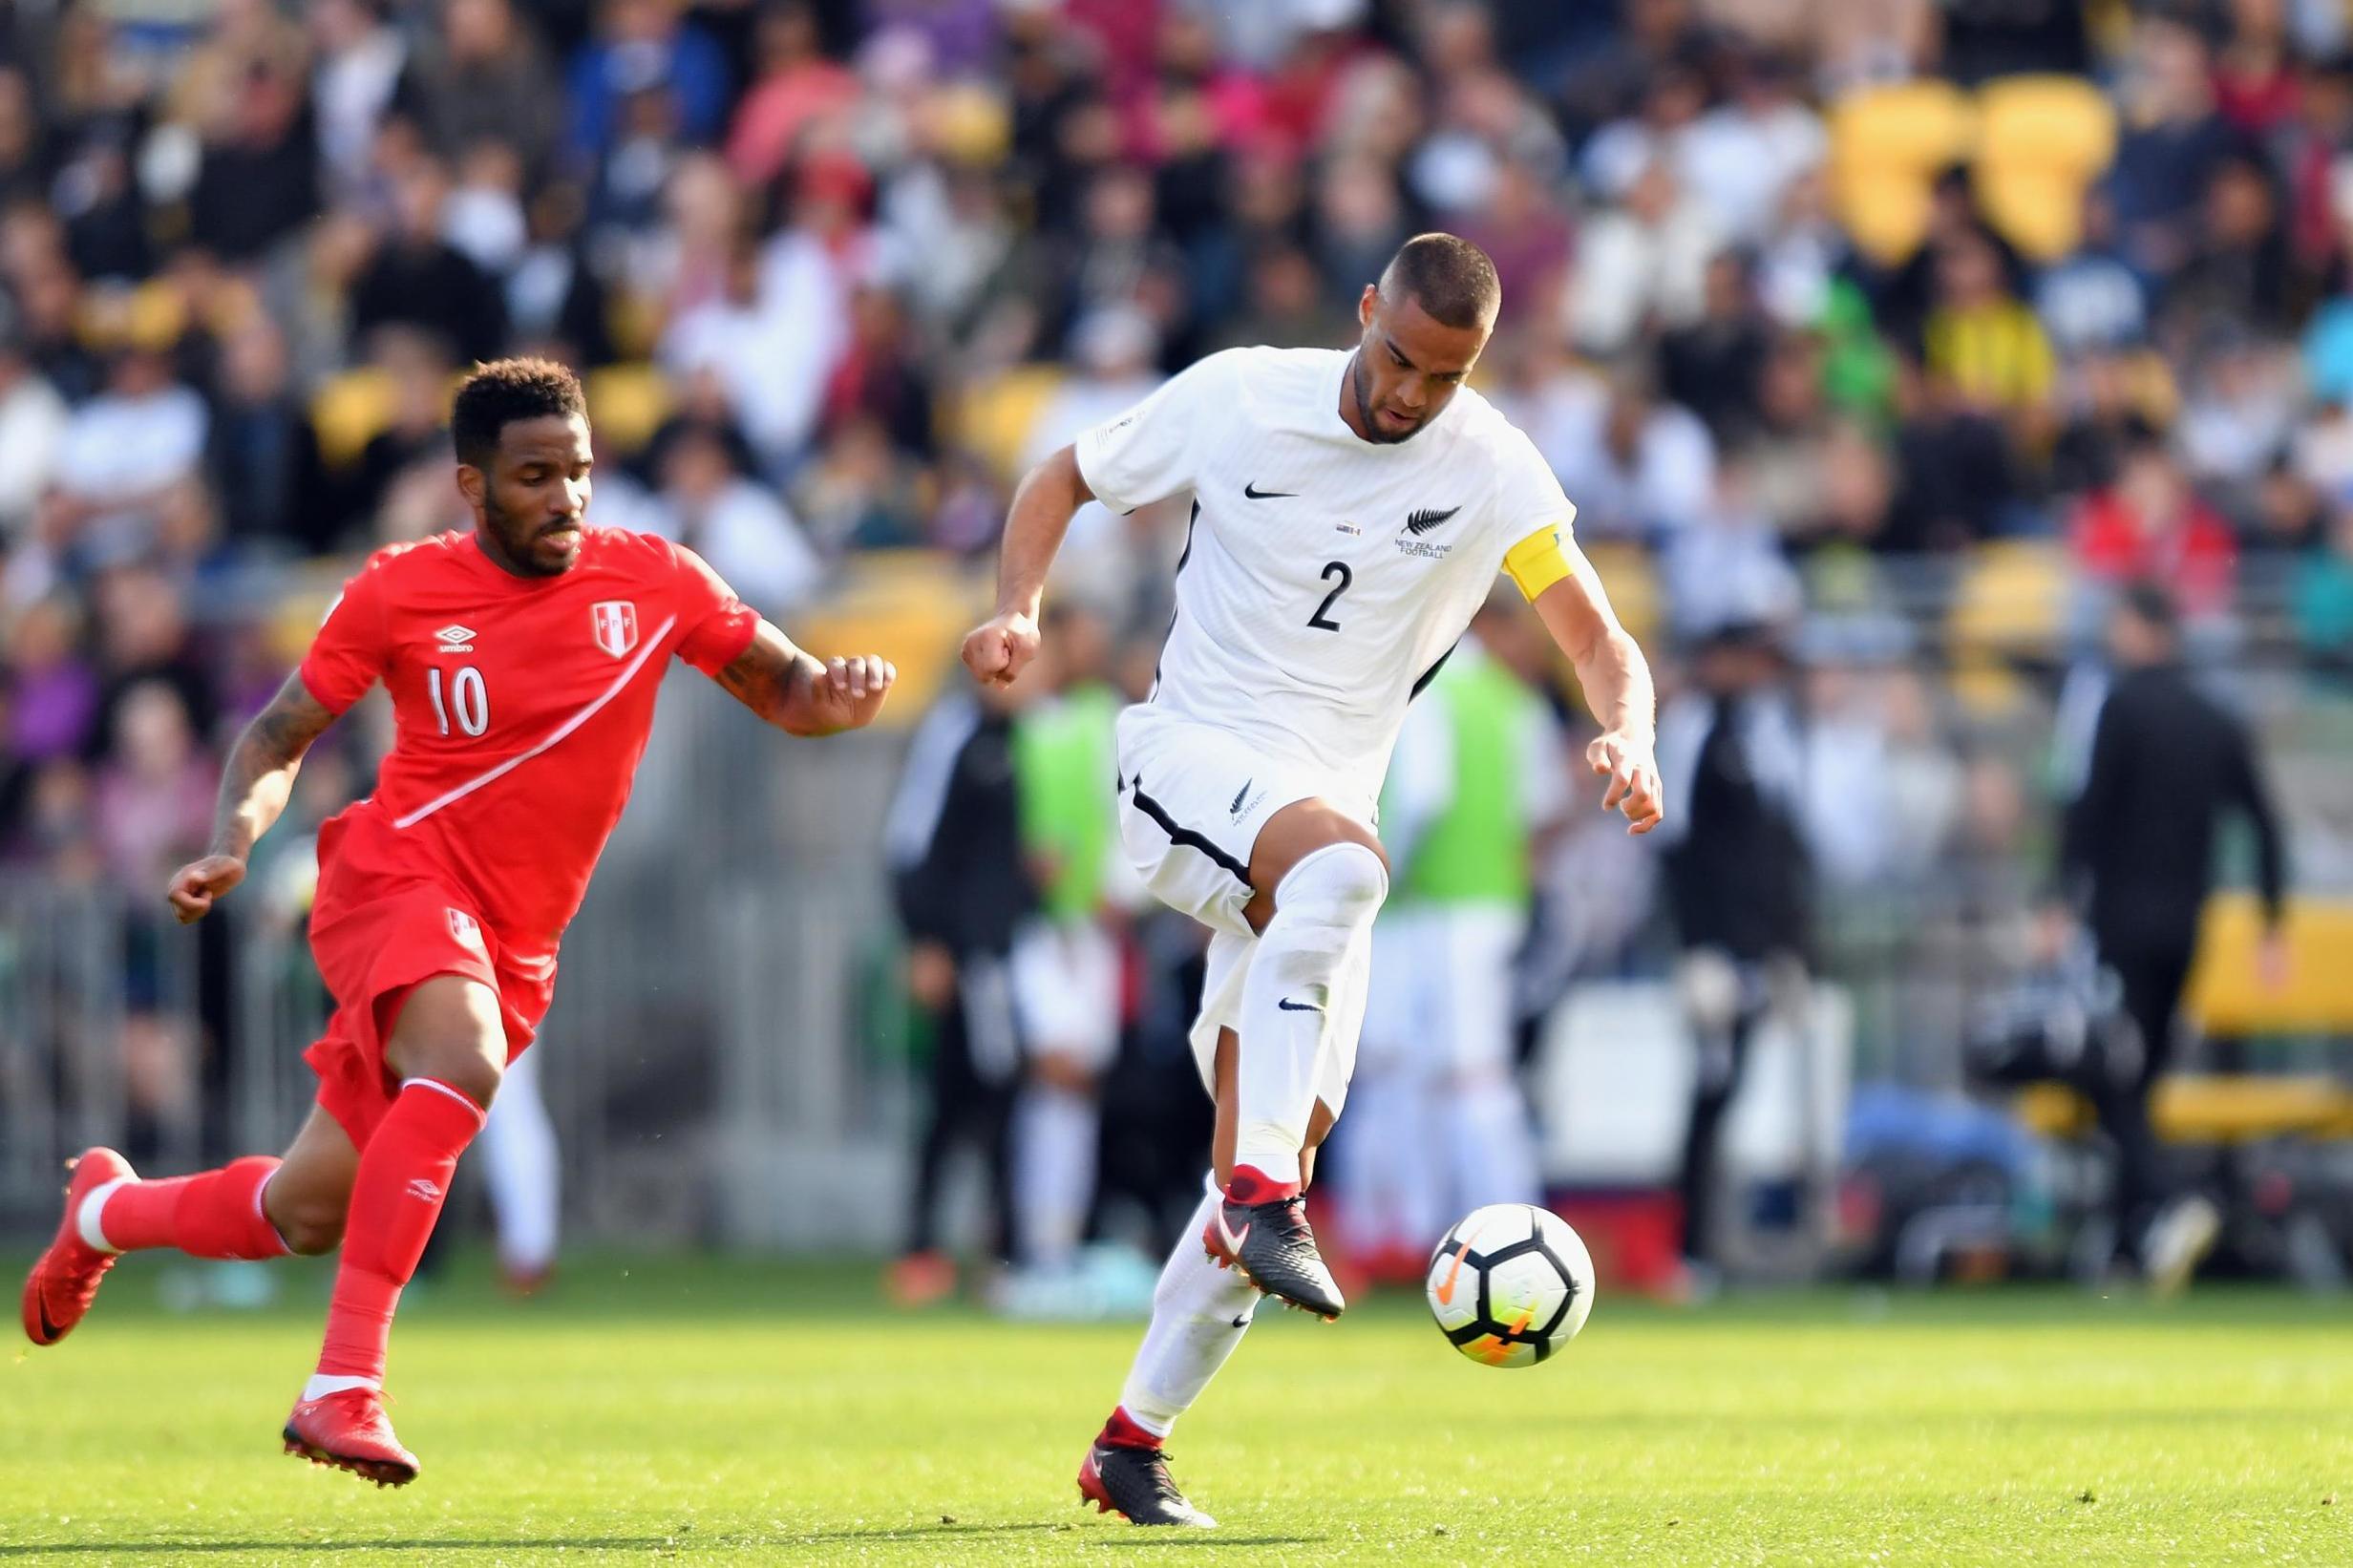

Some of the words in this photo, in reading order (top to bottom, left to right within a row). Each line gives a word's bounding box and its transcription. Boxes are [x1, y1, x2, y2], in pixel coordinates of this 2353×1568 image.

[1394, 539, 1412, 548] NEW
[1414, 541, 1452, 553] ZEALAND
[1400, 546, 1443, 560] FOOTBALL
[1306, 561, 1352, 632] 2
[438, 644, 475, 653] umbro
[429, 666, 489, 737] 10
